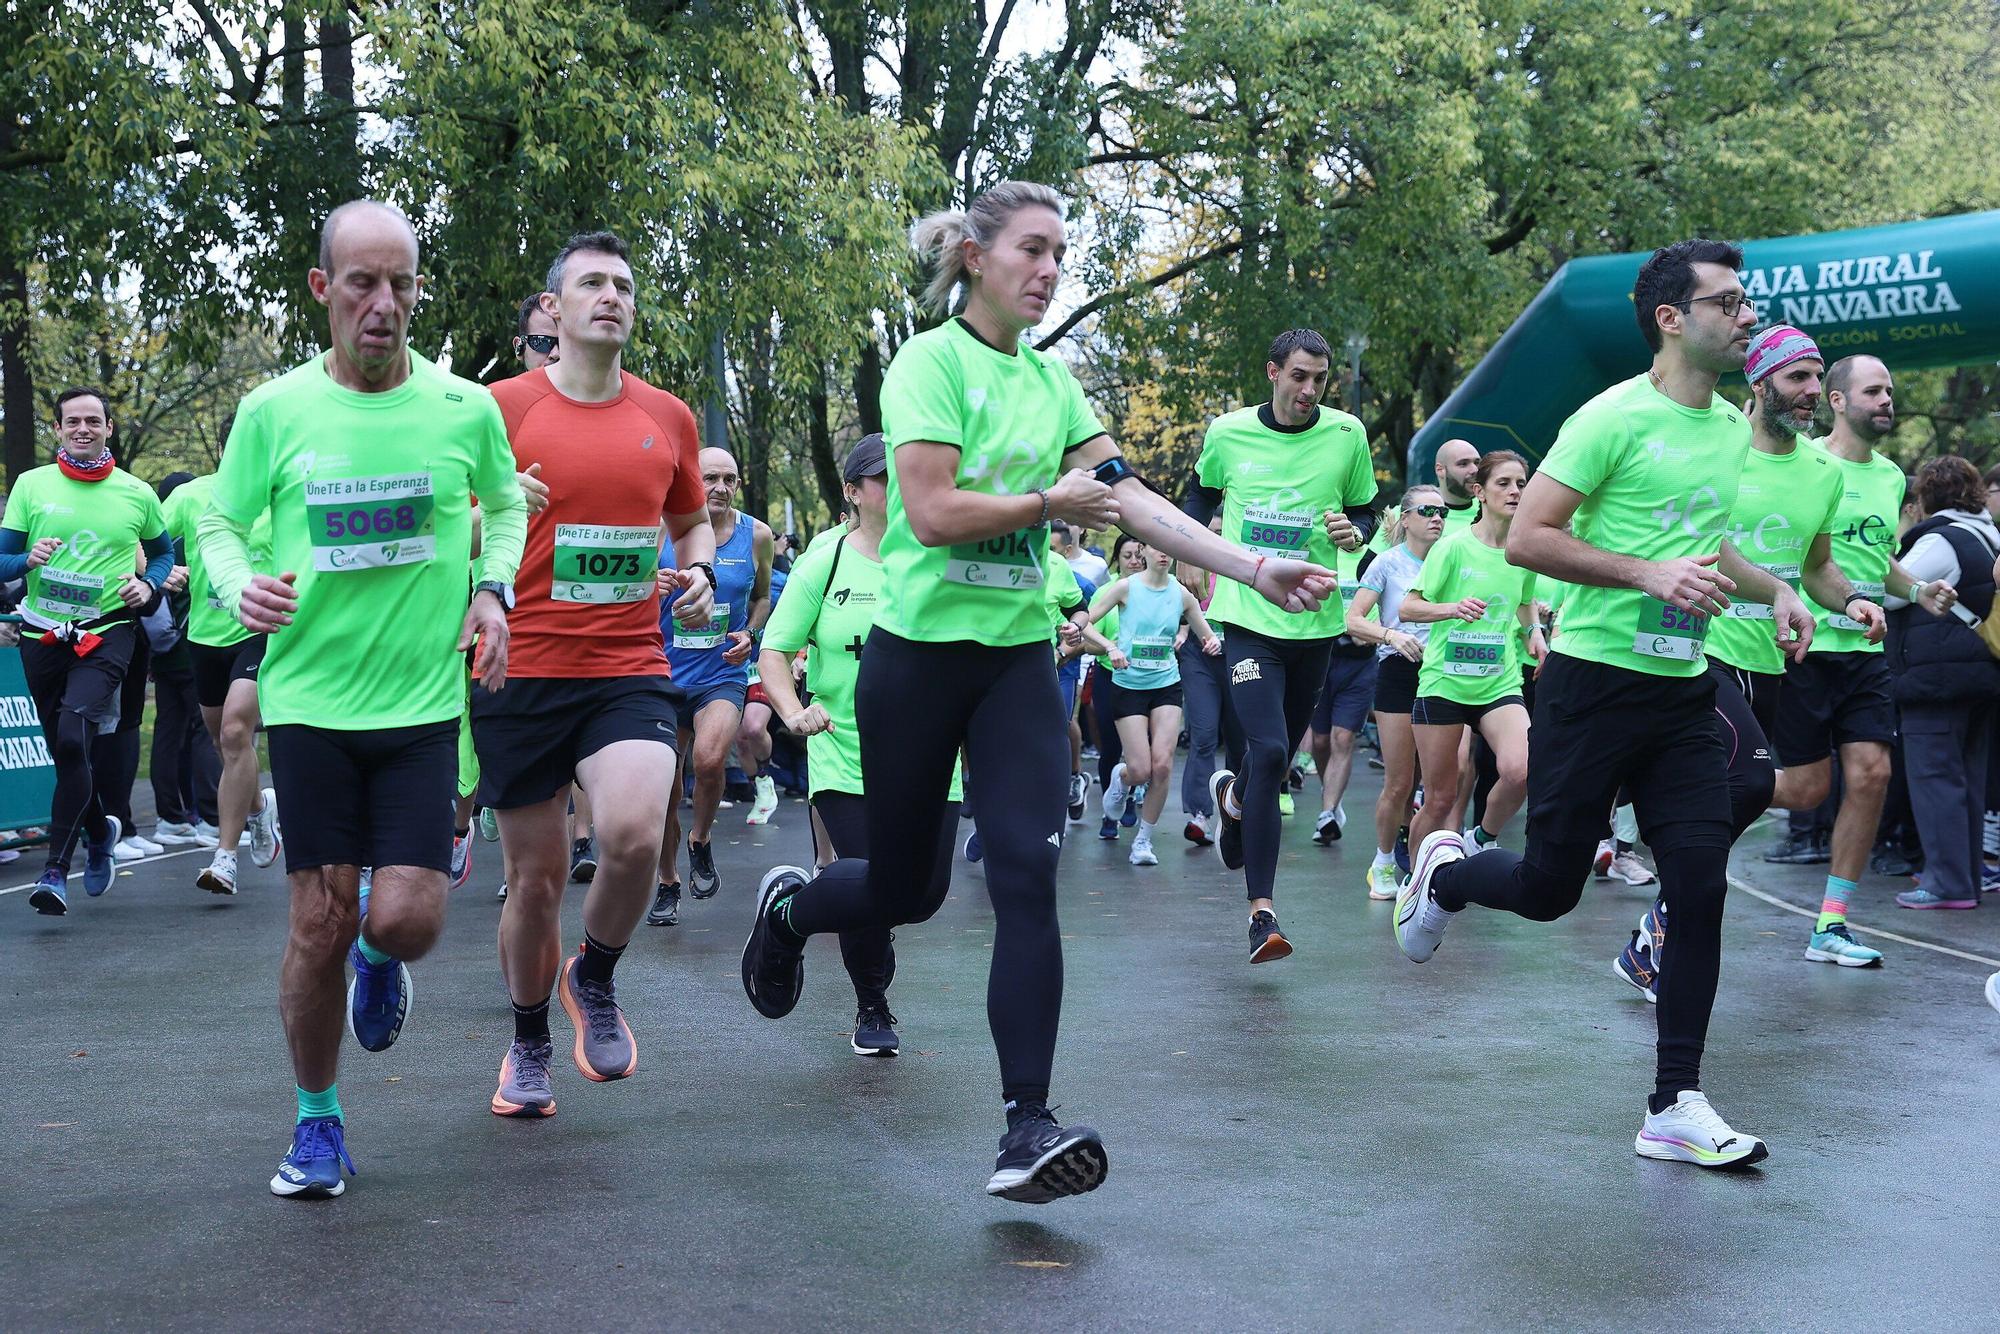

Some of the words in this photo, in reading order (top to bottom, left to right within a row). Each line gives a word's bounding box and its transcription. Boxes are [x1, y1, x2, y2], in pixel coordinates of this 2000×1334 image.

[1815, 250, 1942, 290] RURAL
[1754, 299, 1772, 330] E
[1781, 282, 1962, 325] NAVARRA
[1888, 321, 1967, 342] SOCIAL
[307, 481, 342, 496] ÚneTE
[345, 485, 352, 494] a
[356, 481, 366, 493] la
[370, 477, 429, 493] Esperanza
[414, 487, 429, 495] 2025
[325, 505, 416, 538] 5068
[1278, 513, 1311, 523] Esperanza
[557, 526, 591, 539] ÚneTE
[593, 531, 599, 539] a
[602, 530, 611, 540] la
[613, 530, 657, 542] Esperanza
[1250, 526, 1301, 546] 5067
[576, 553, 640, 576] 1073
[49, 584, 90, 602] 5016
[1454, 646, 1497, 660] 5066
[1232, 671, 1262, 686] PASCUAL
